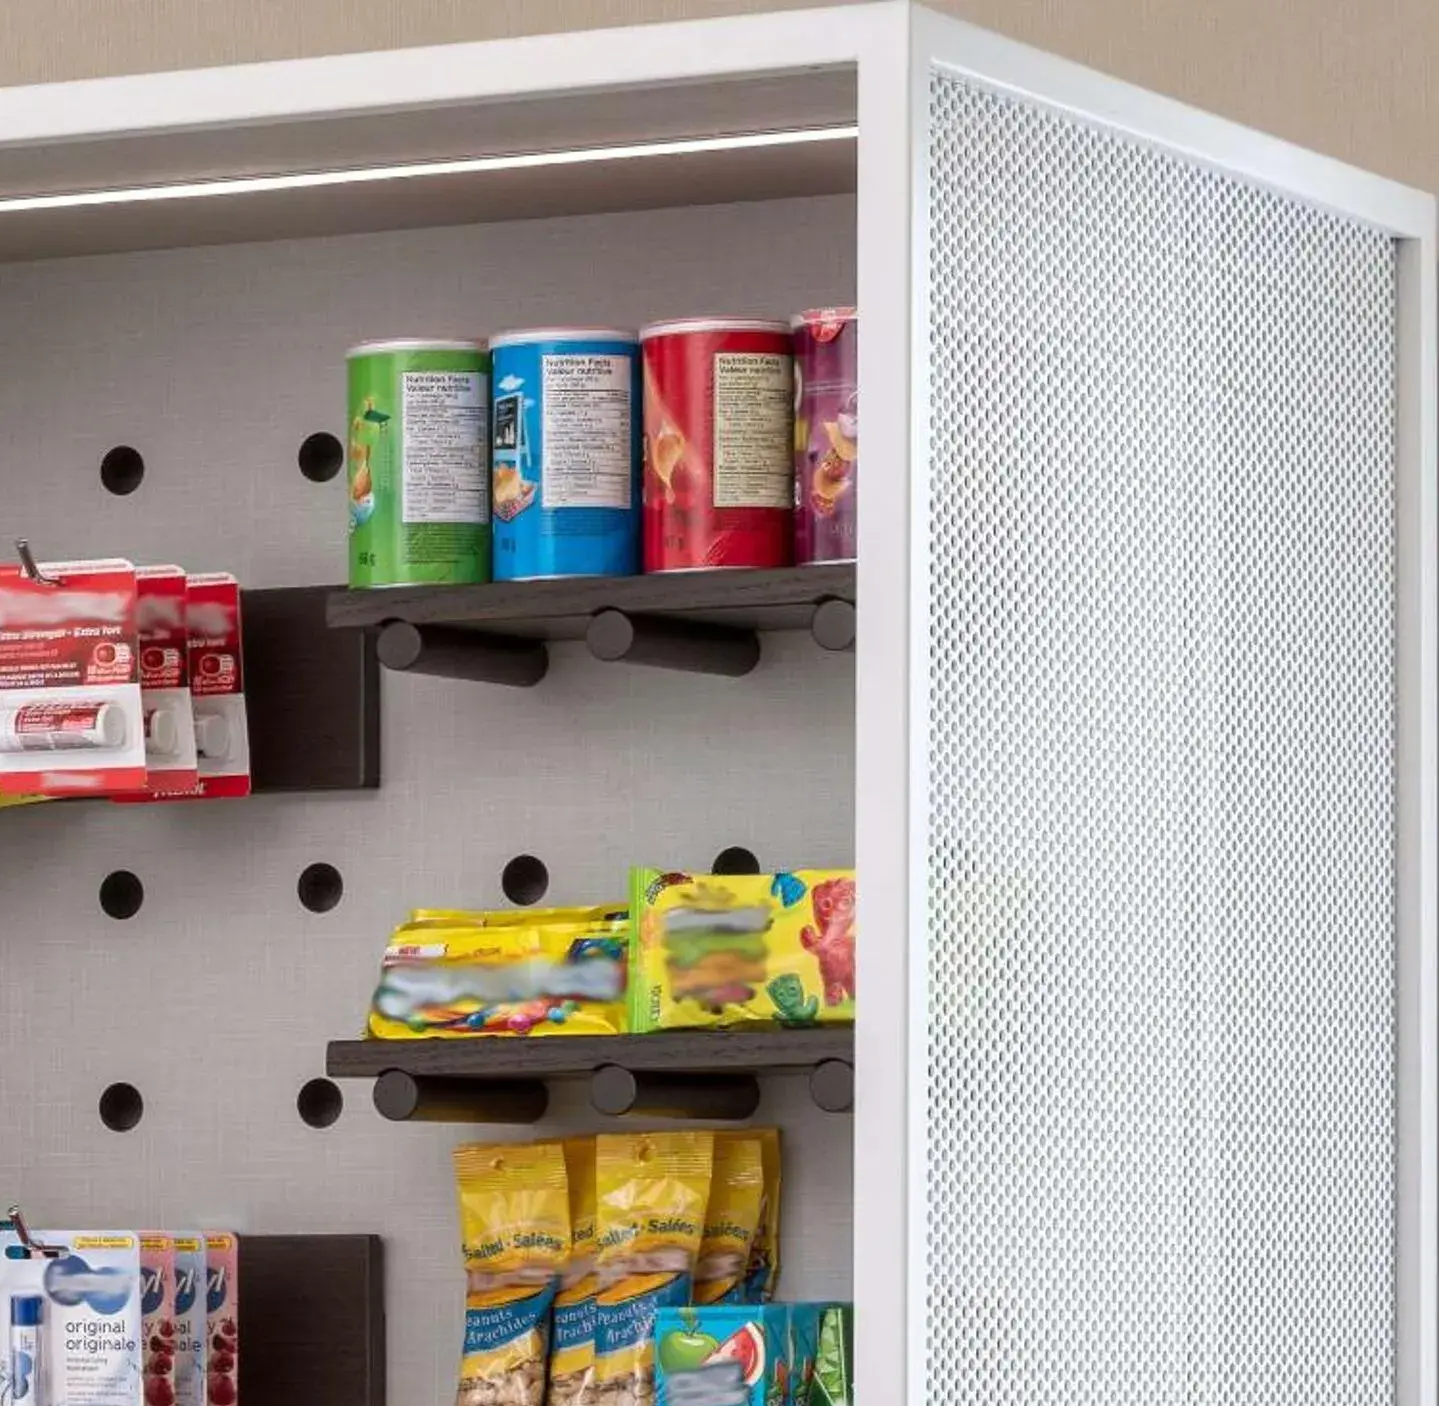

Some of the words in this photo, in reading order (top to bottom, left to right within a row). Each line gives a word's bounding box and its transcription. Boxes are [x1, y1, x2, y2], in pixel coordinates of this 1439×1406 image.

[554, 1303, 597, 1324] eanuts
[65, 1319, 127, 1337] original
[65, 1333, 137, 1354] originale
